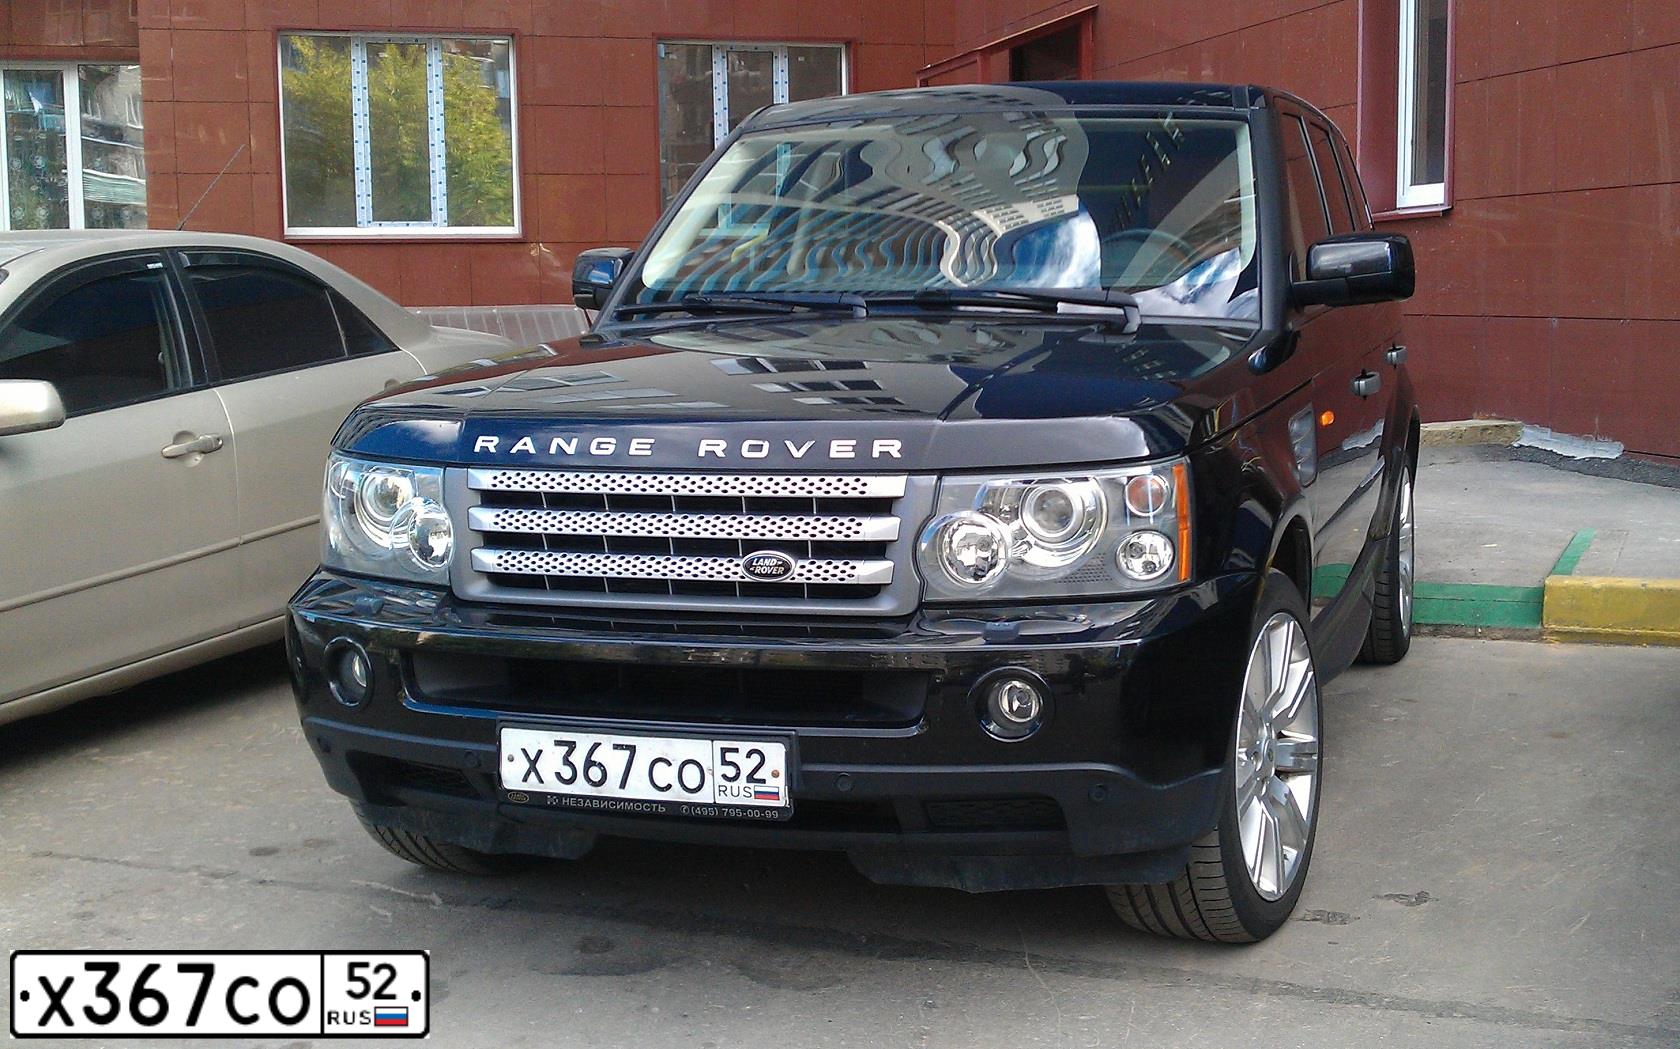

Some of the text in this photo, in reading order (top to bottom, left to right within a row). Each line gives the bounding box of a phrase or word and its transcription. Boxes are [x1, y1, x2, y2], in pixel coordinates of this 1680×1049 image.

[474, 434, 903, 459] RANGE ROVER
[752, 558, 777, 566] LAND
[754, 566, 785, 575] ROVER
[719, 746, 767, 785] 52
[718, 784, 753, 798] RUS
[562, 797, 666, 813] НЕЗАВИСИМОСТЬ
[691, 806, 779, 819] (495) 795-00-99
